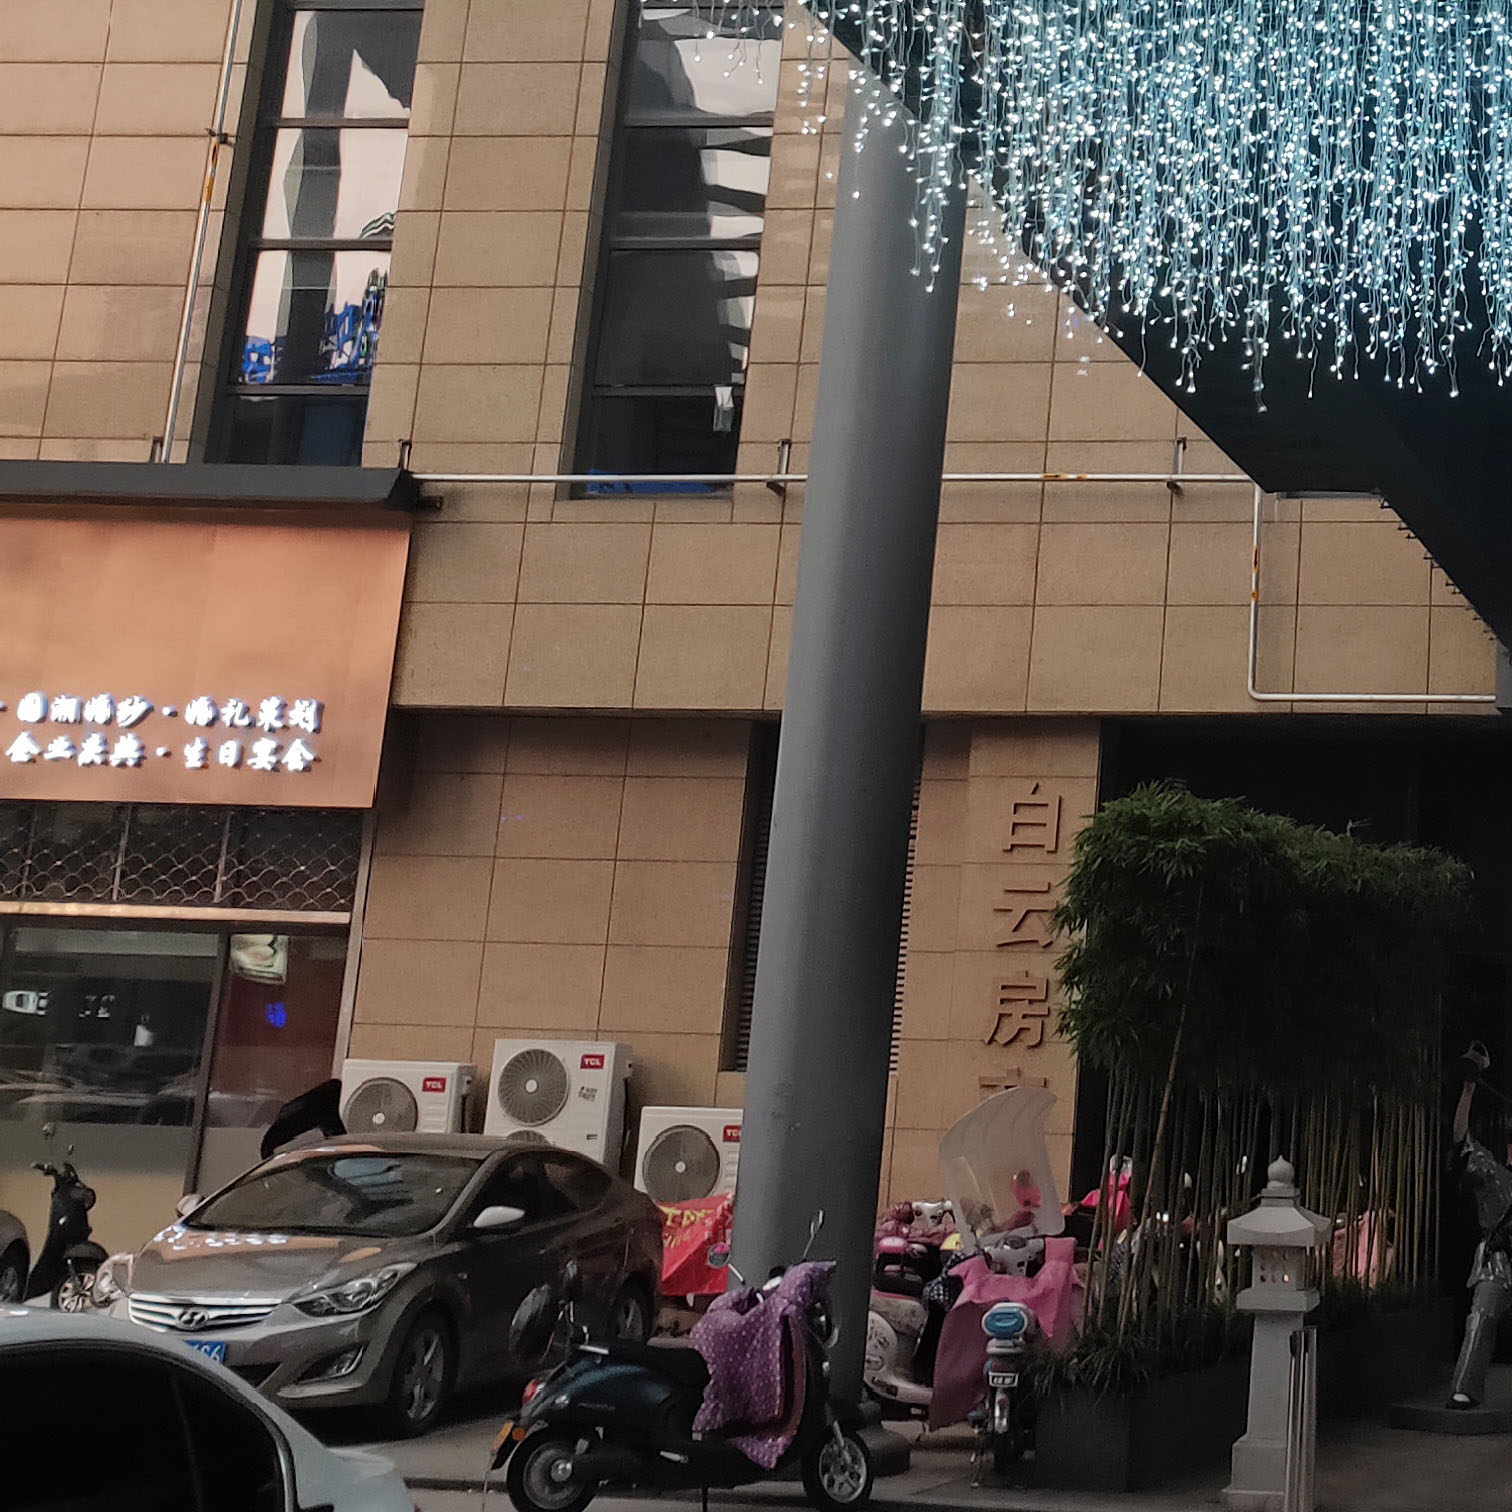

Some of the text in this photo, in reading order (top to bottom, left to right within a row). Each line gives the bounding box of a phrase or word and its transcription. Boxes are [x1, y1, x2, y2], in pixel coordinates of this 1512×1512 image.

[978, 781, 1063, 1099] 白云房
[582, 1057, 603, 1067] TCL
[424, 1079, 444, 1090] TCL
